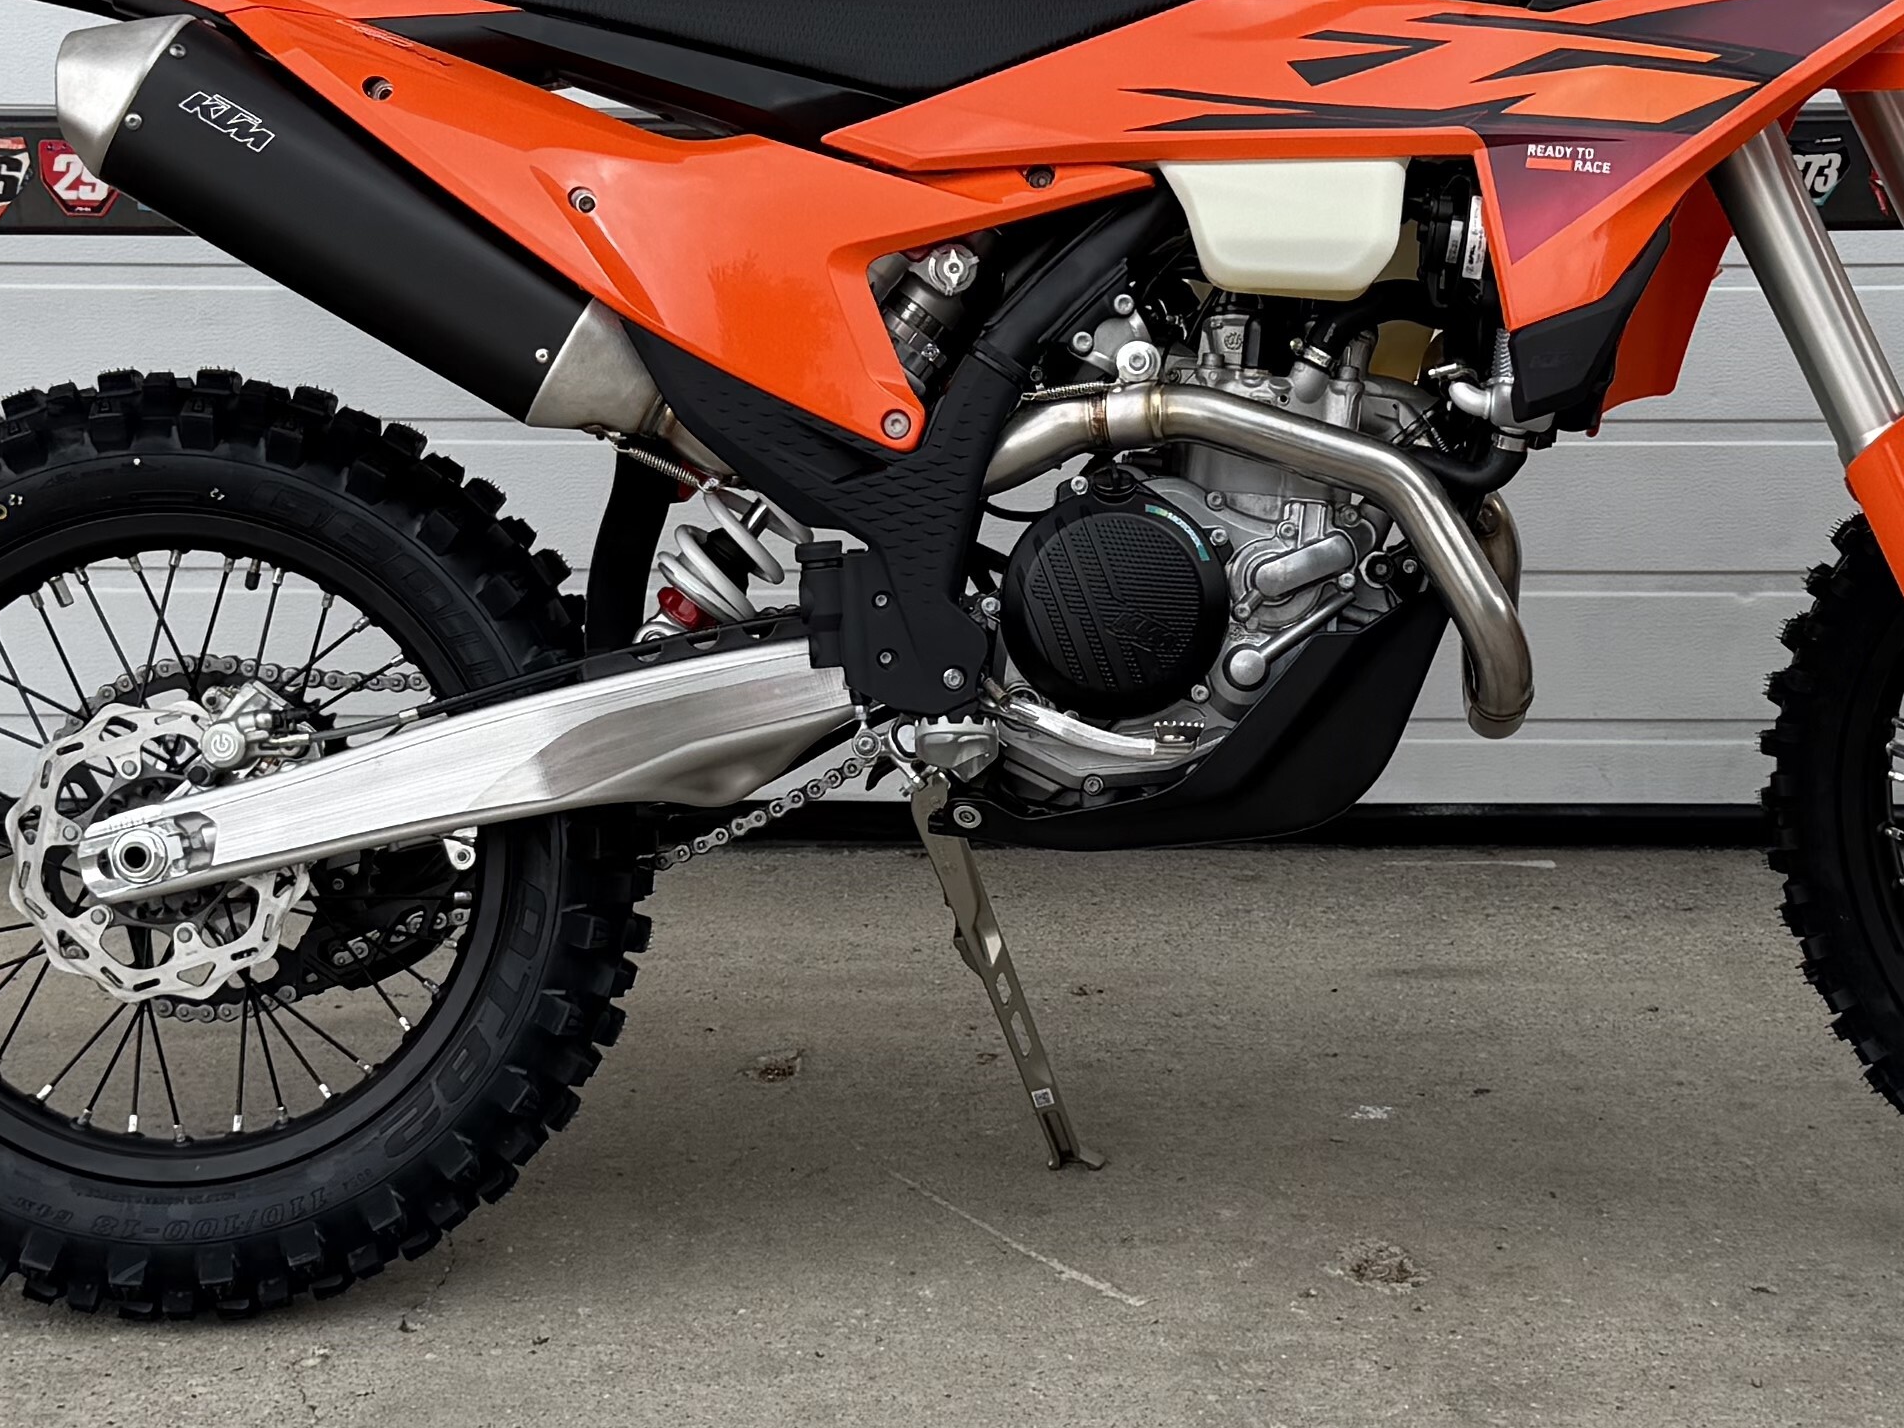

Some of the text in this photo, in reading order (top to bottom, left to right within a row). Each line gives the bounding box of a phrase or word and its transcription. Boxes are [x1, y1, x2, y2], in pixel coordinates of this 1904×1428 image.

[178, 91, 275, 152] KTM
[1527, 144, 1594, 159] READY TO
[1574, 160, 1611, 174] RACE
